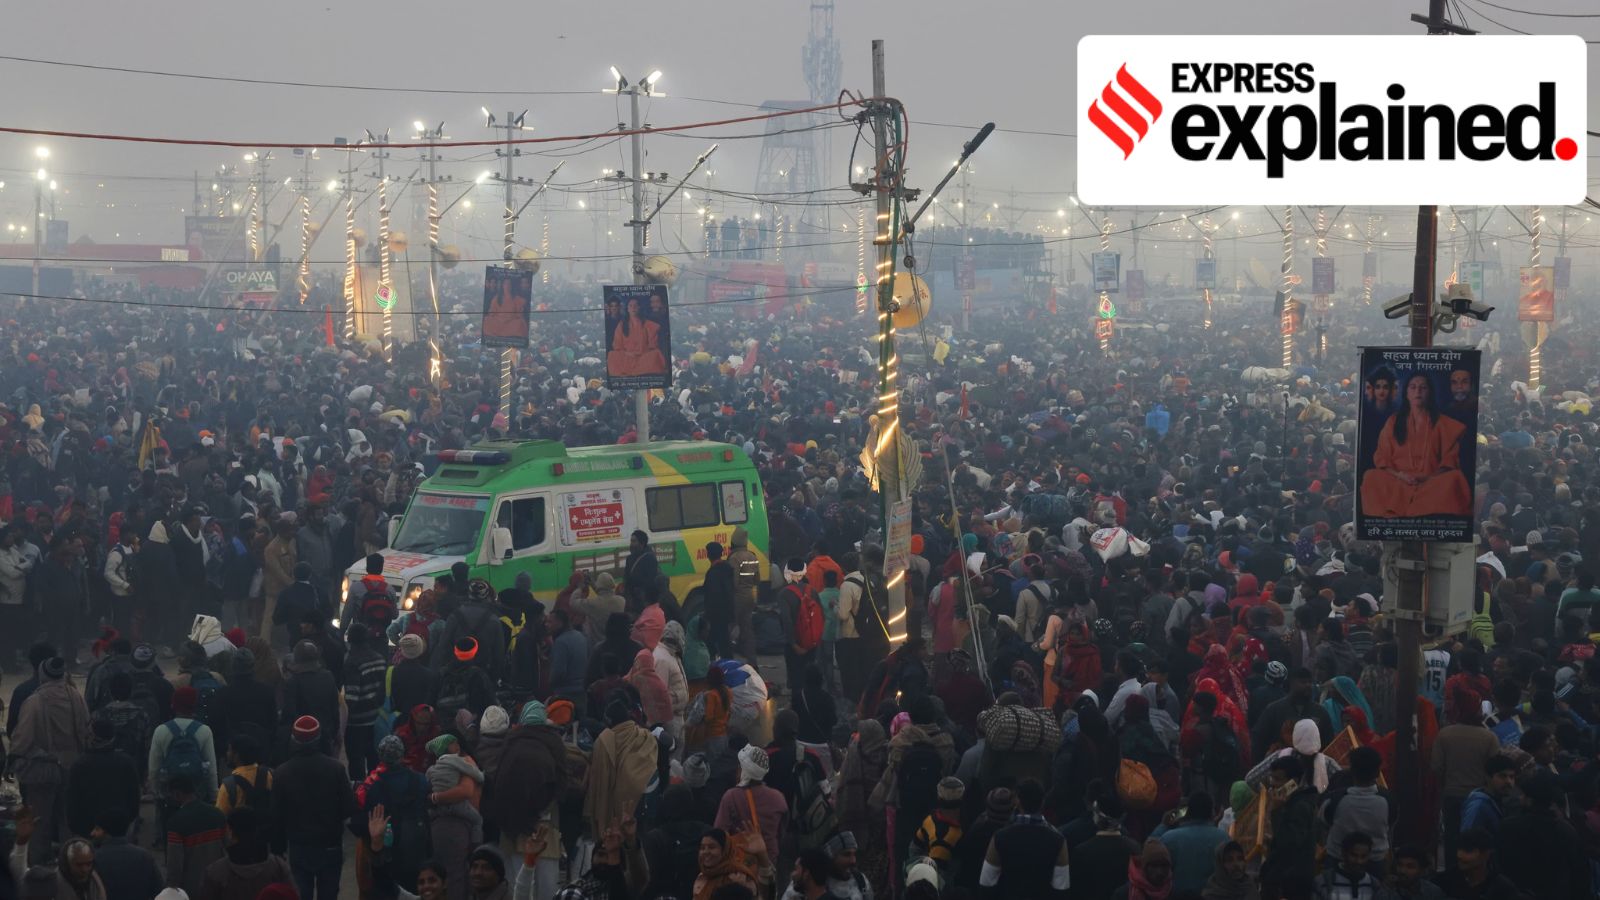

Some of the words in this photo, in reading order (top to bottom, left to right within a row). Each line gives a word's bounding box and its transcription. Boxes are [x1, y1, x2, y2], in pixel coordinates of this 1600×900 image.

[1383, 351, 1410, 361] सहज
[1413, 352, 1438, 360] ध्यान
[1441, 350, 1462, 360] योग
[1395, 362, 1412, 371] जय
[1417, 361, 1452, 371] गिरनारी
[1367, 527, 1380, 537] हरि
[1426, 670, 1441, 692] 15
